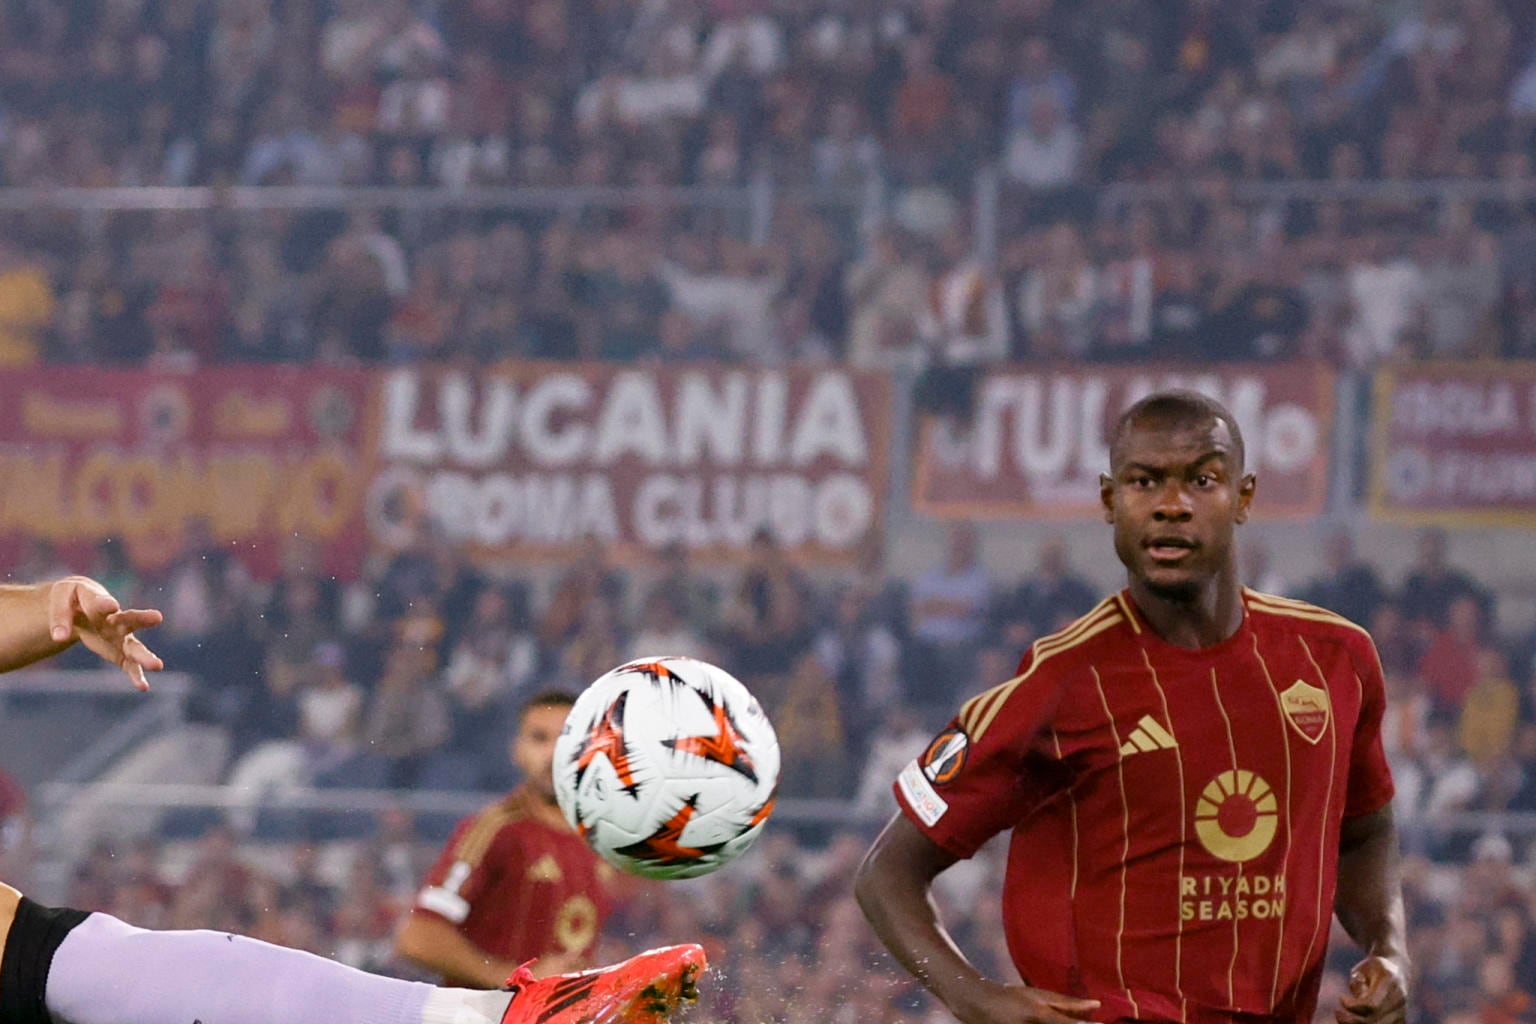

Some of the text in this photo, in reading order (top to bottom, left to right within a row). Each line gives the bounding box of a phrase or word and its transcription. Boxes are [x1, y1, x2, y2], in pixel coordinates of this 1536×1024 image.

[378, 370, 868, 466] LUCANIA
[1182, 875, 1284, 895] RIYADH
[1182, 900, 1283, 920] SEASON
